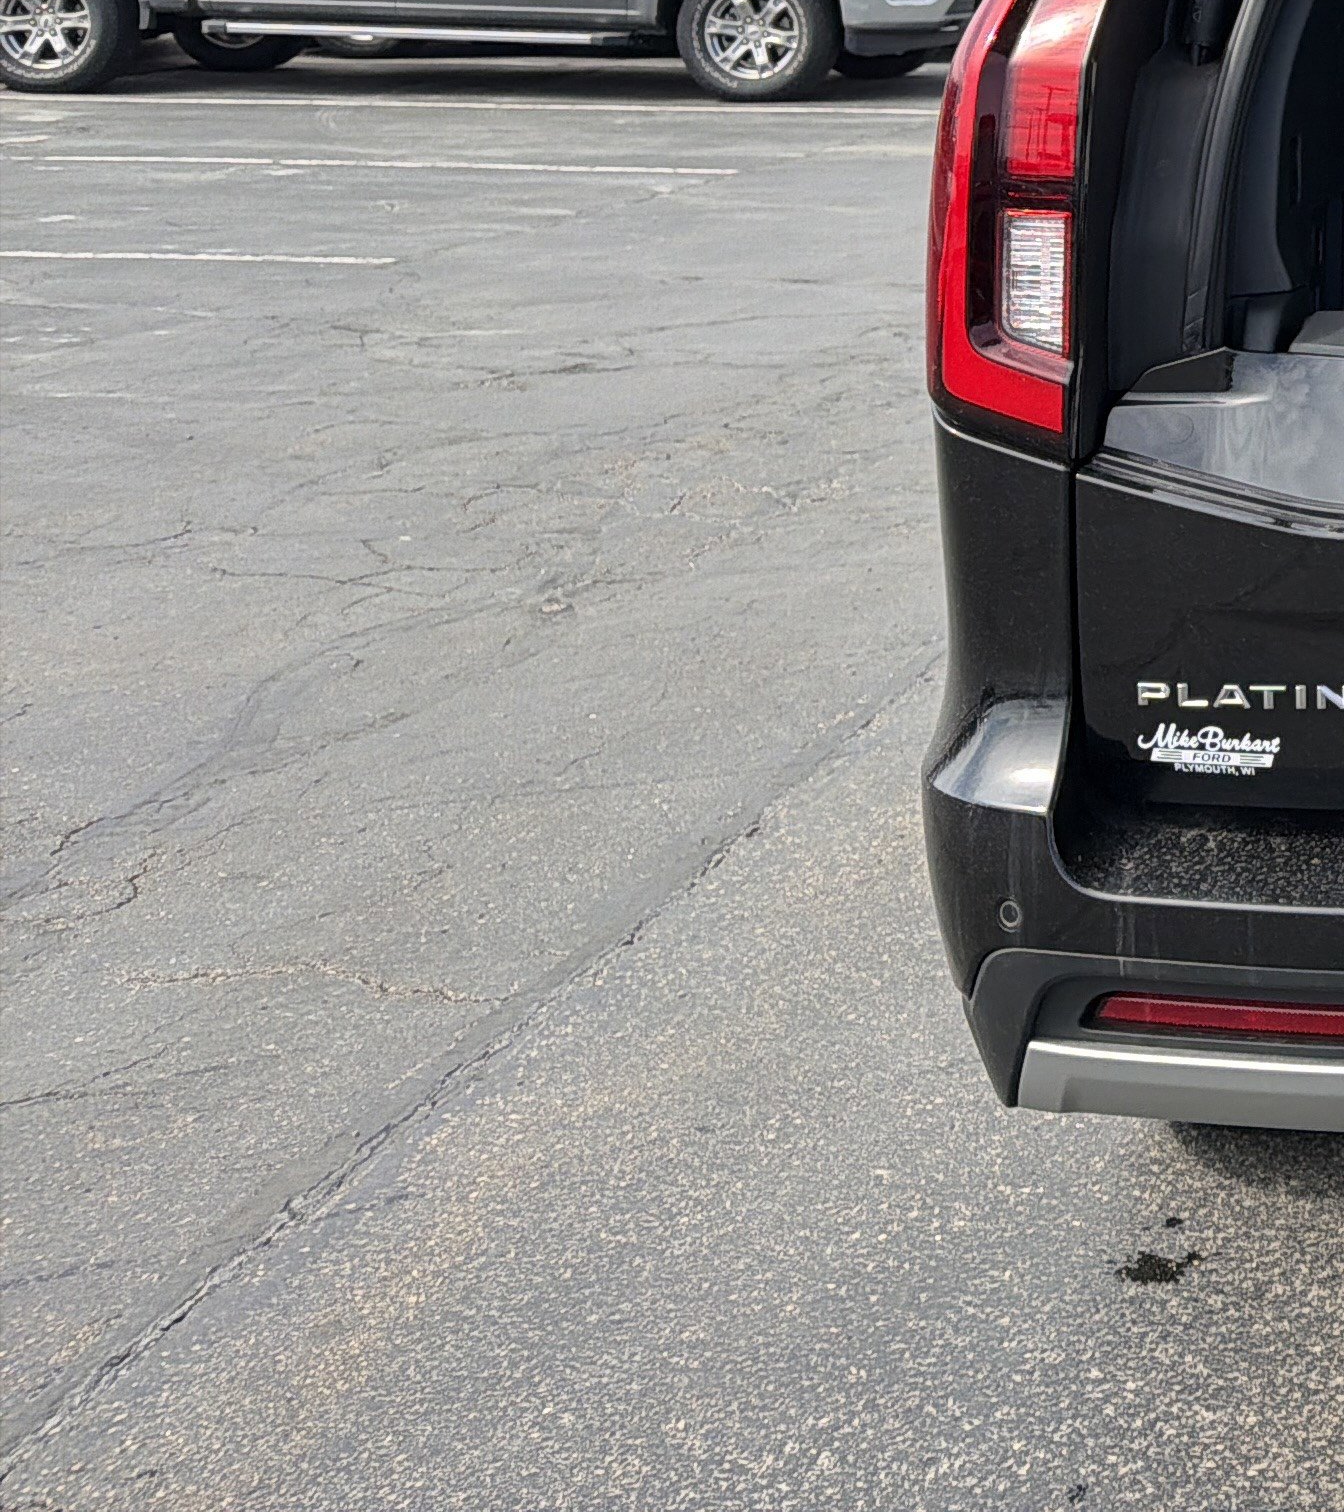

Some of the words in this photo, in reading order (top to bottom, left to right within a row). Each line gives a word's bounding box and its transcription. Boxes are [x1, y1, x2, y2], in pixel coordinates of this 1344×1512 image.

[1137, 722, 1199, 750] Mike
[1197, 725, 1281, 754] Burkart
[1192, 752, 1232, 764] FORD
[1174, 762, 1239, 776] PLYMOUTH,
[1240, 766, 1256, 776] WI
